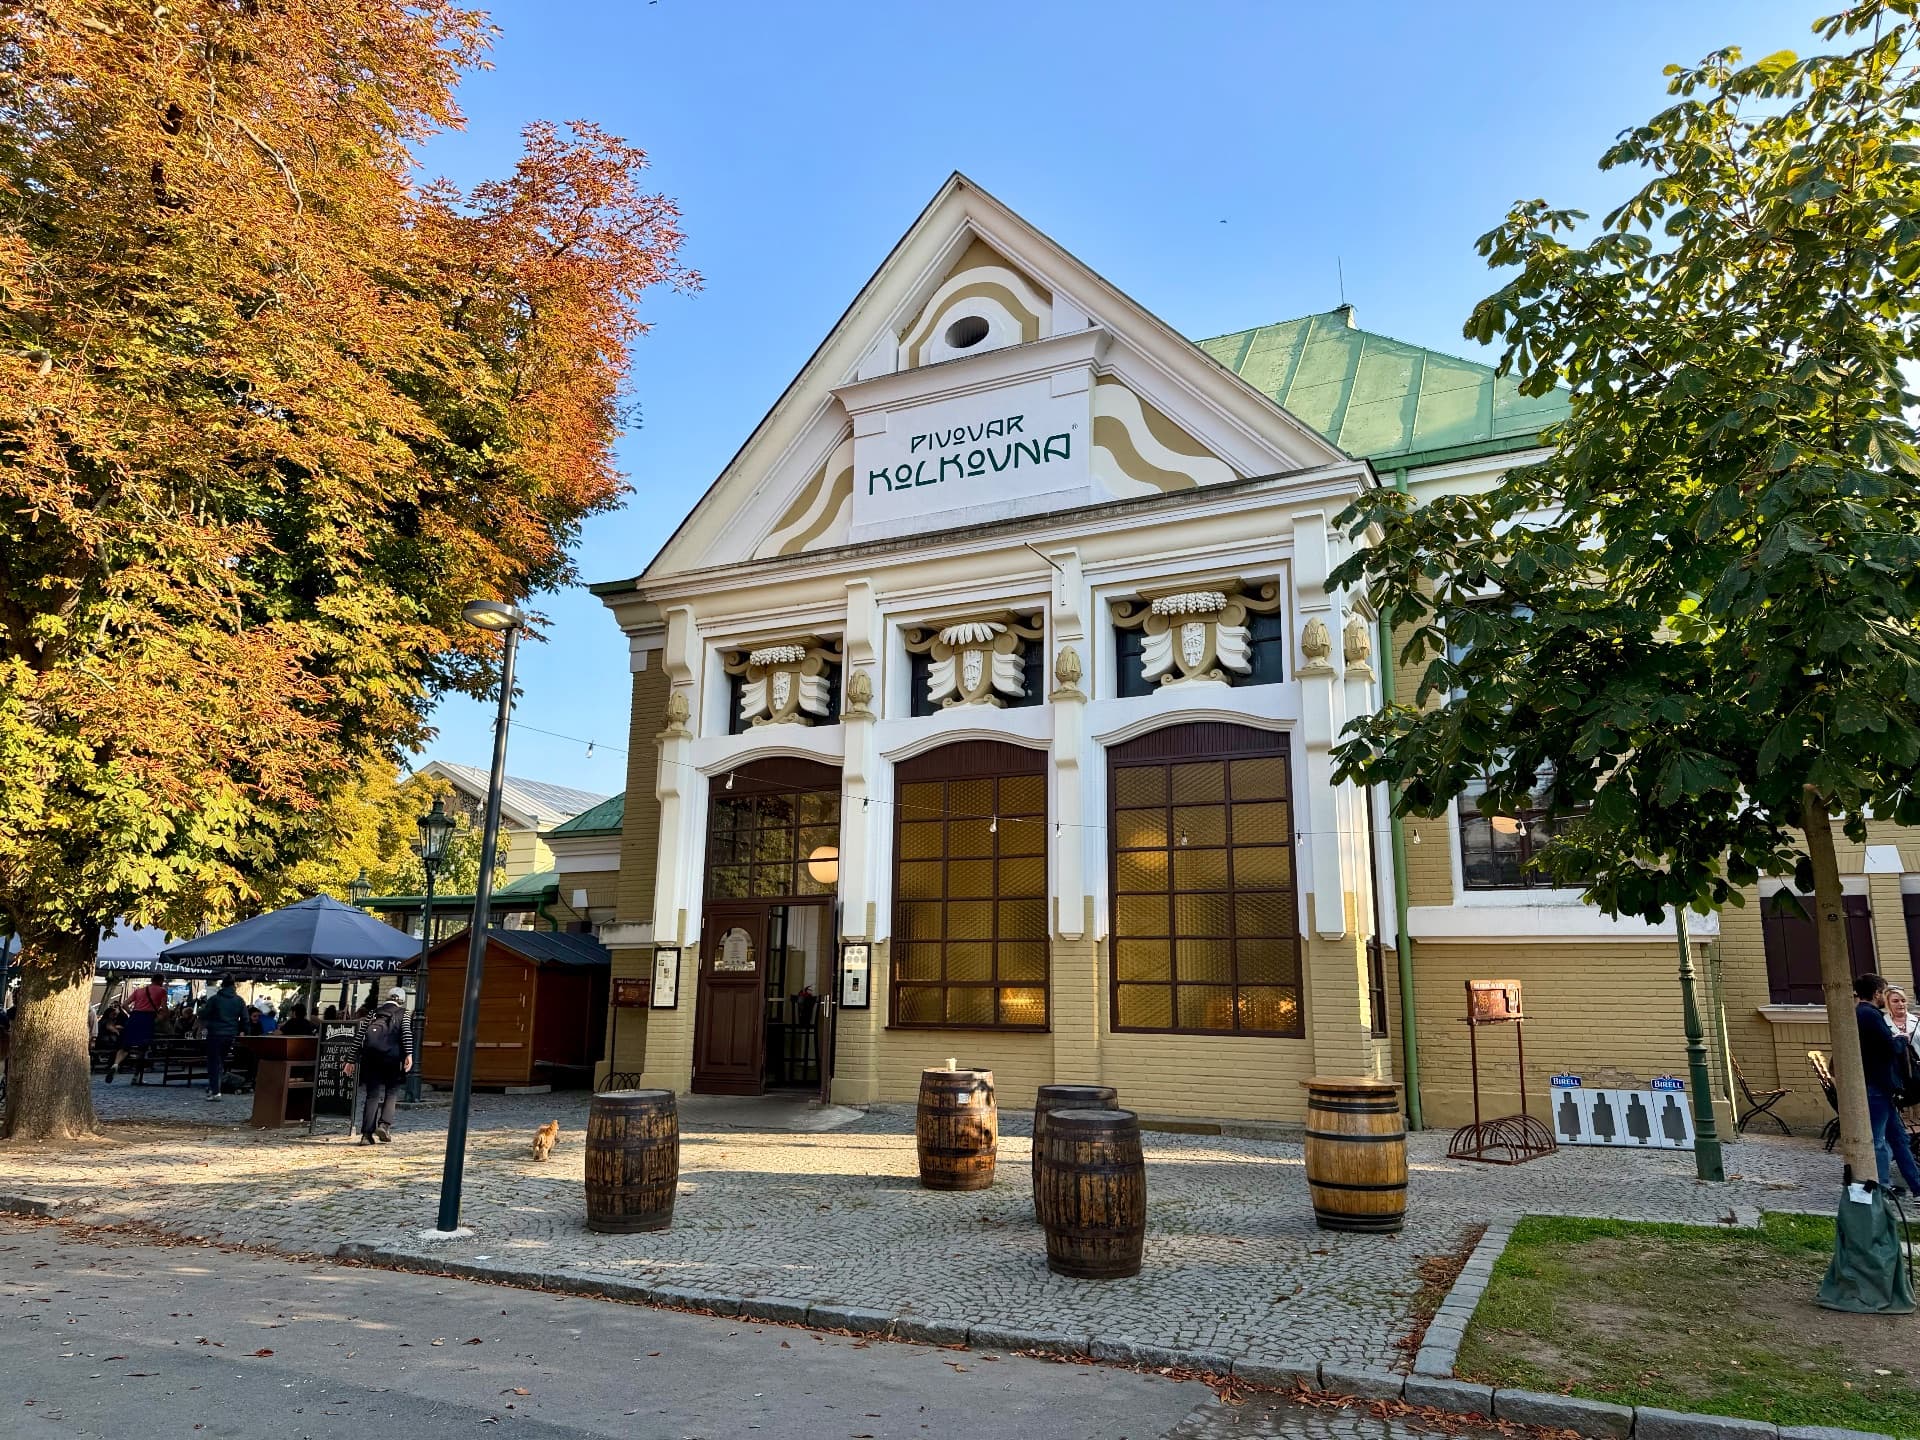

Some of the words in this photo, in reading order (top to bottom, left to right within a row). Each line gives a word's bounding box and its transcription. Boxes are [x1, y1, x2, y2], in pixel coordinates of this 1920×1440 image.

[911, 415, 1024, 453] PIVOVAR
[868, 433, 1071, 495] KOLKOVNA
[99, 960, 152, 971] PIVOVAR
[179, 954, 225, 968] PIVOVAR
[227, 953, 286, 967] KOLKOVNA
[333, 958, 385, 970] PIVOVAR
[1553, 1077, 1580, 1086] BIRELL
[1654, 1080, 1682, 1089] BIRELL
